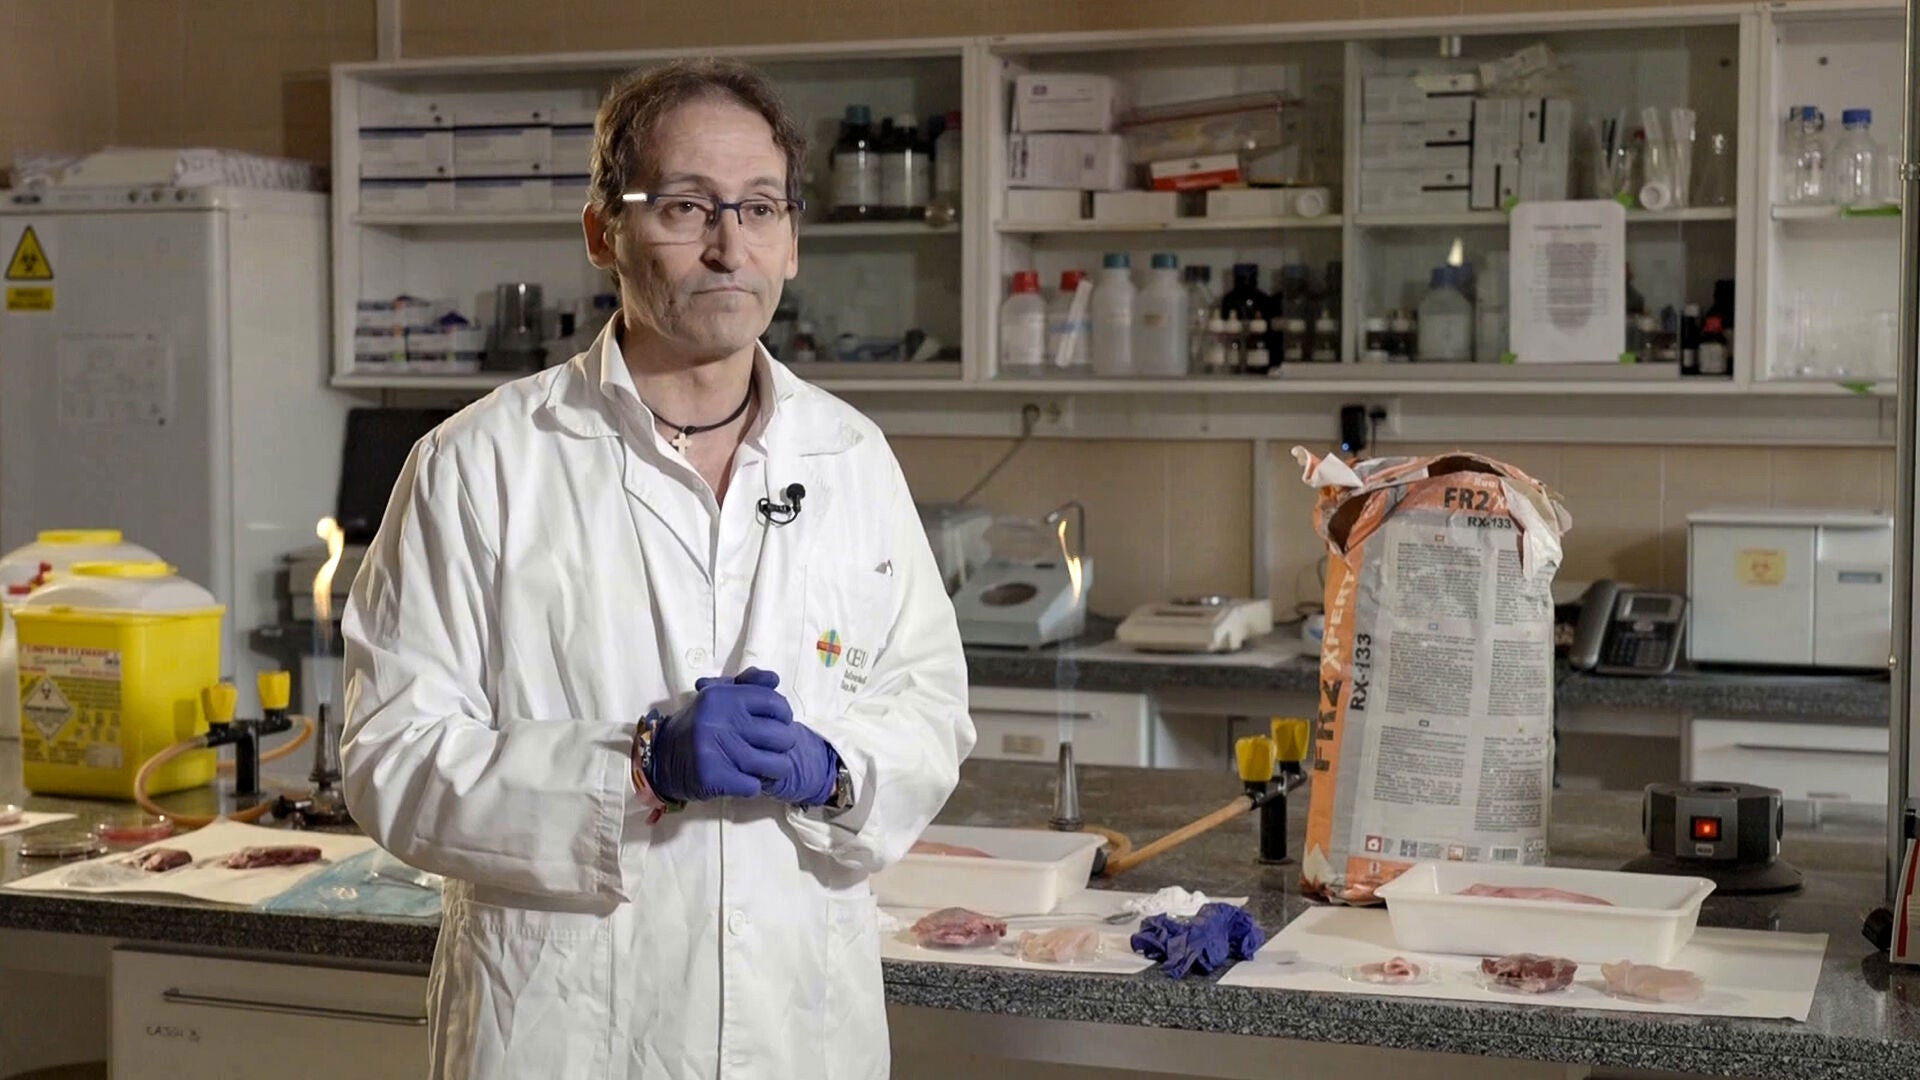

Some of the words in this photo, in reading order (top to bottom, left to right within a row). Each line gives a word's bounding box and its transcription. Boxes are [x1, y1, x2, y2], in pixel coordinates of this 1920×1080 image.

[1444, 486, 1489, 511] FR2
[1467, 516, 1512, 528] RX-133
[1350, 633, 1372, 711] RX-133
